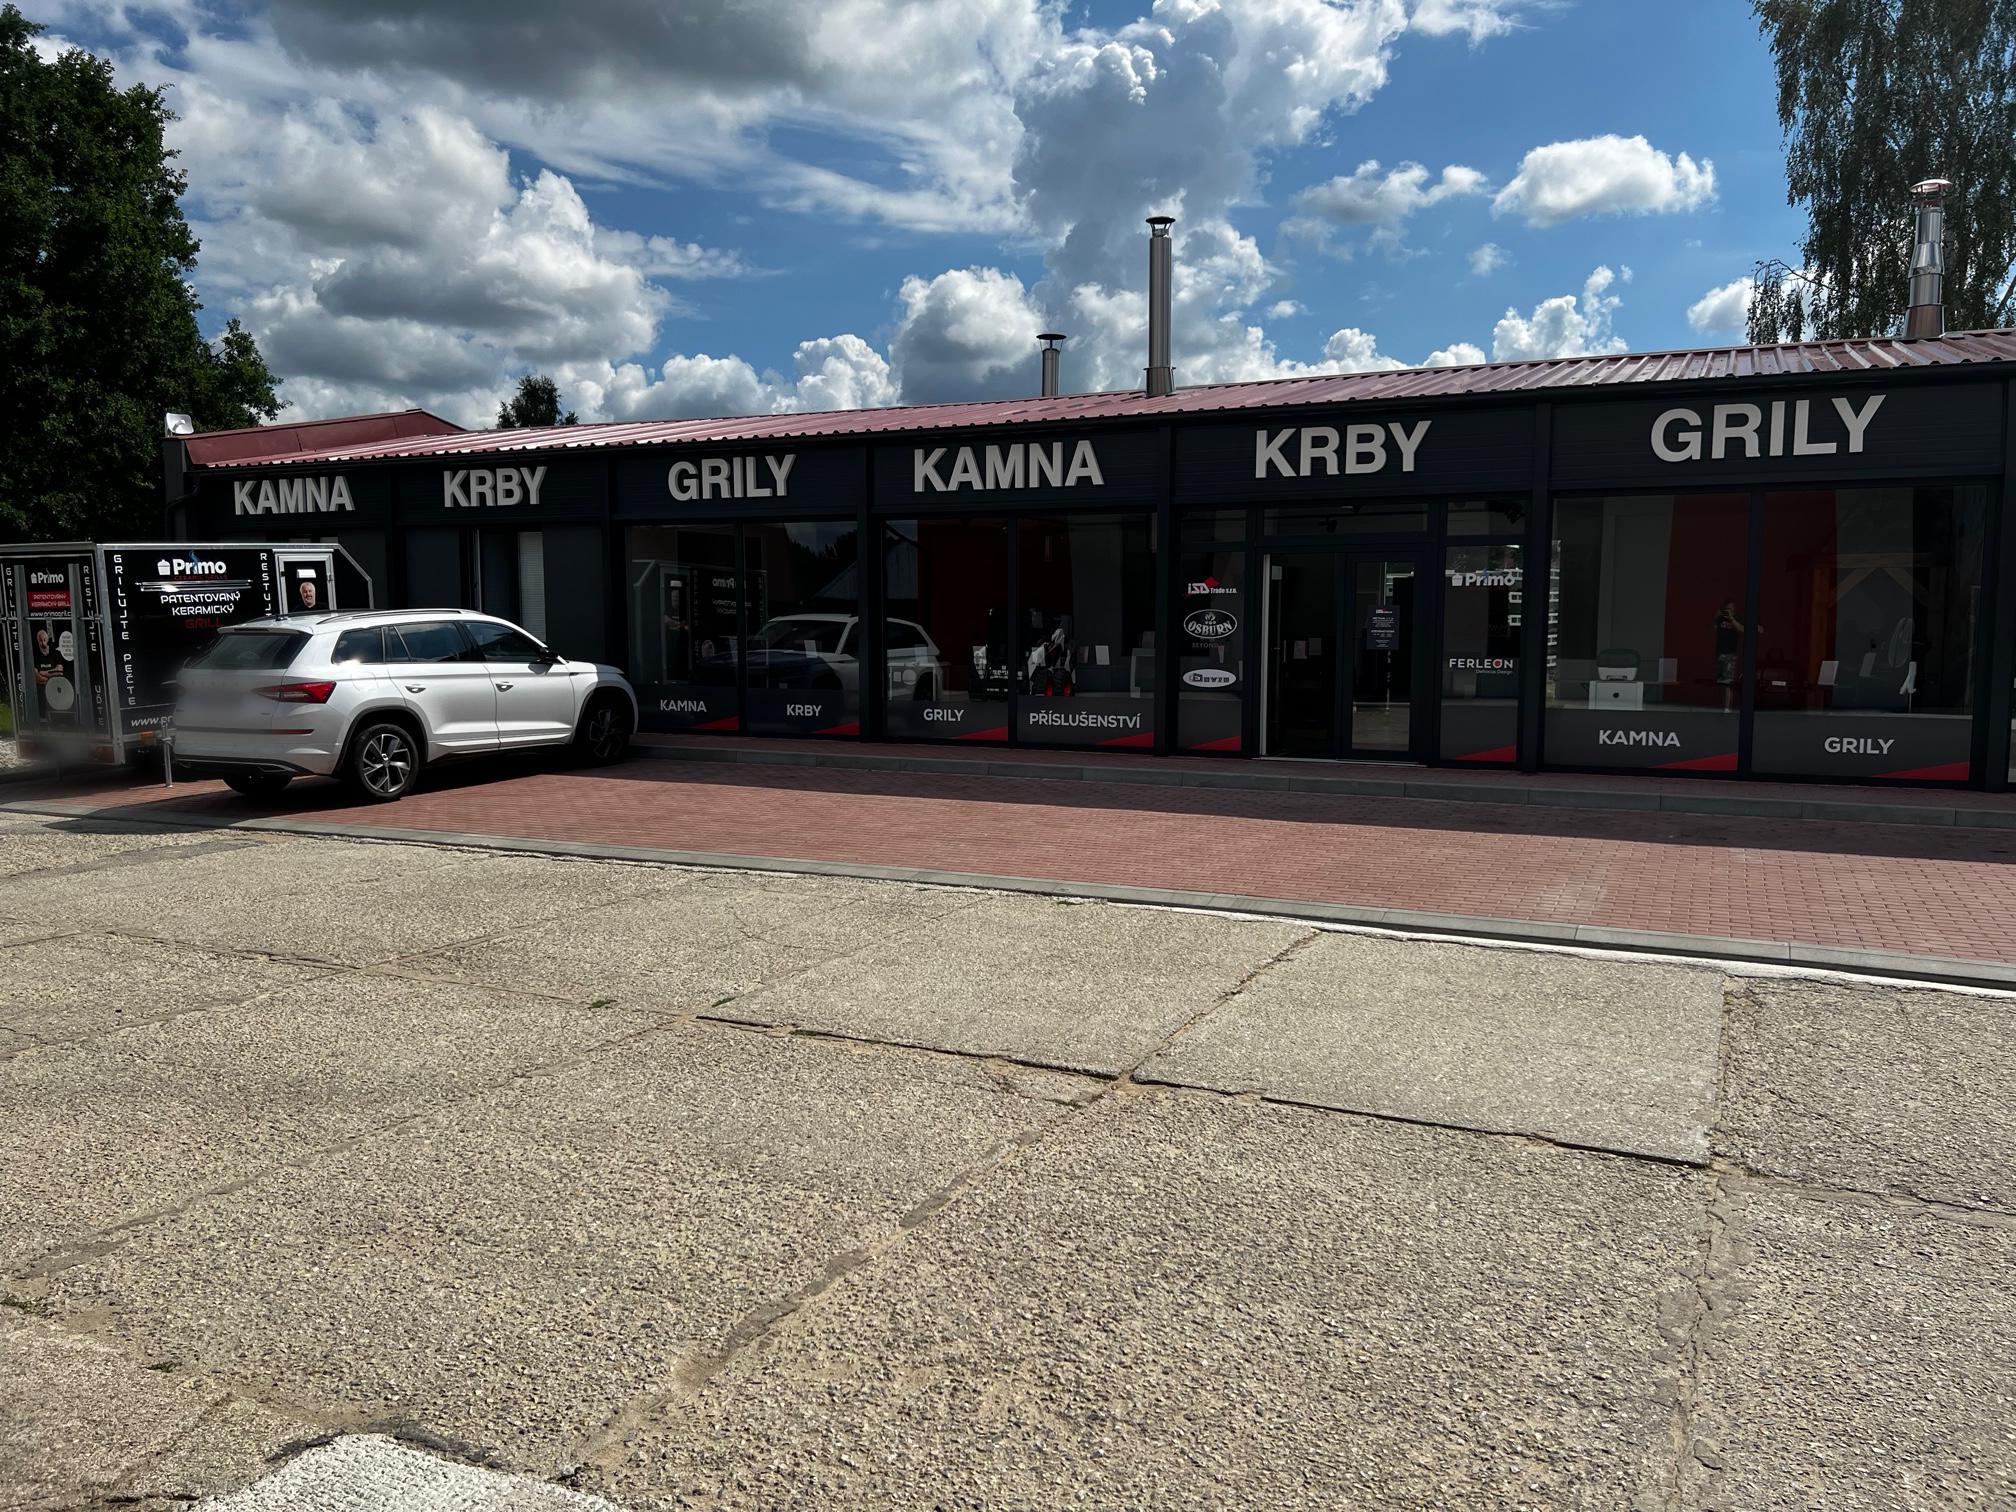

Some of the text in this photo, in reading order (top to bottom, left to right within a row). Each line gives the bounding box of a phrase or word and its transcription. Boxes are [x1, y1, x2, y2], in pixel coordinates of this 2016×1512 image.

[1651, 394, 1886, 462] GRILY
[1255, 420, 1432, 479] KRBY
[914, 440, 1104, 493] KAMNA
[443, 466, 547, 508] KRBY
[668, 454, 797, 501] GRILY
[233, 476, 355, 515] KAMNA
[172, 558, 227, 576] Primo
[37, 572, 64, 584] Primo
[1465, 573, 1515, 587] Primo
[113, 554, 130, 640] GRILUJTE
[160, 591, 241, 604] PATENTOVANÝ
[172, 602, 235, 616] KERAMICKÝ
[1187, 620, 1233, 637] OSBURN
[1449, 658, 1514, 669] FERLEON
[123, 653, 137, 706] PEČTE
[659, 698, 707, 713] KAMNA
[786, 703, 822, 717] KRBY
[923, 708, 964, 723] GRILY
[1029, 710, 1141, 729] PŘÍSLUŠENSTVÍ
[1599, 729, 1680, 748] KAMNA
[1824, 736, 1894, 755] GRILY
